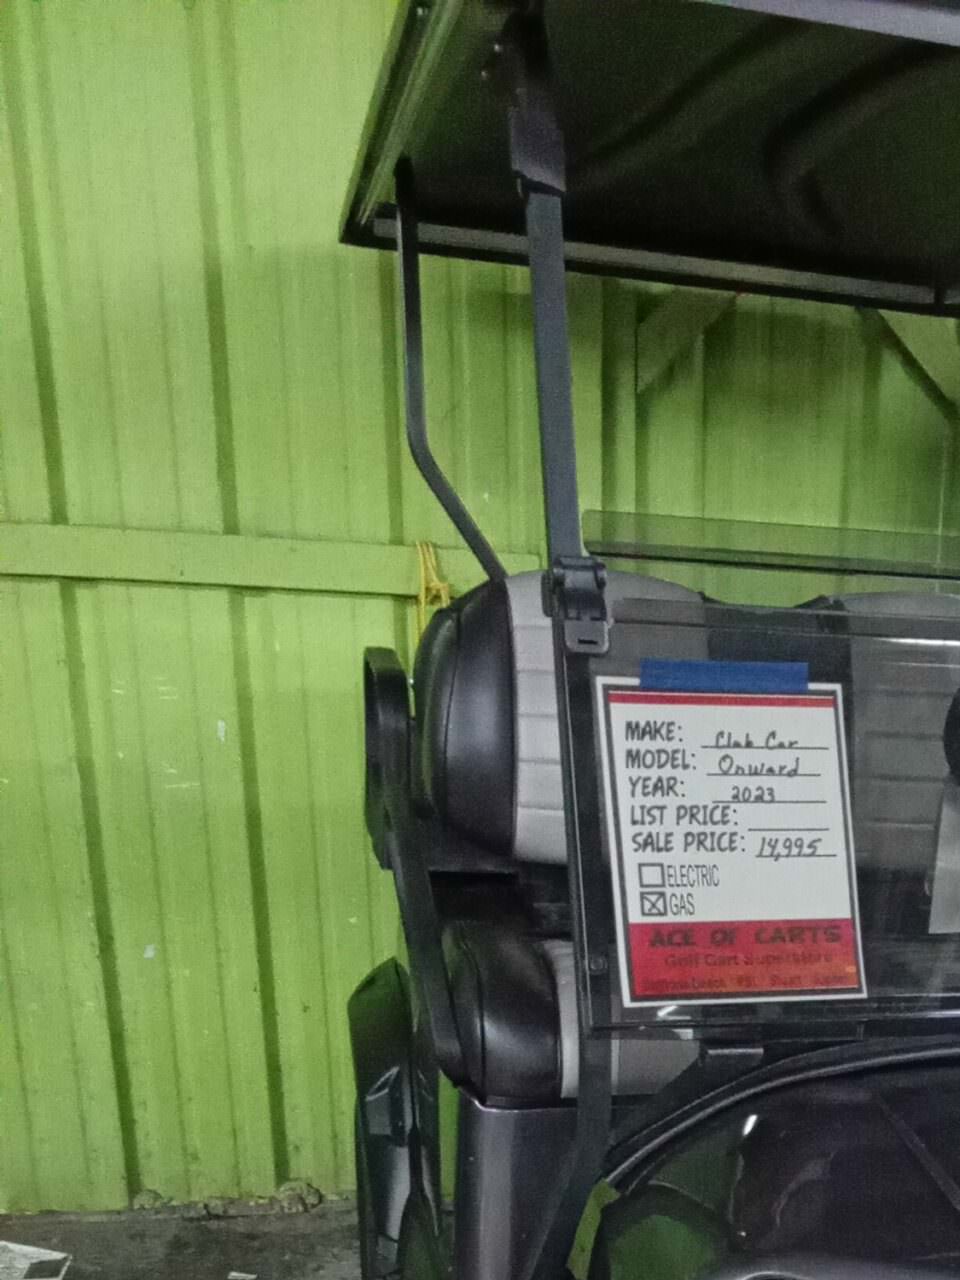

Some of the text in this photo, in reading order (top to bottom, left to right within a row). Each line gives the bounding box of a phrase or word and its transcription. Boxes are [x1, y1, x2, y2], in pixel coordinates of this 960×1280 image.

[625, 721, 683, 742] MAKE:
[764, 731, 799, 748] Car
[625, 749, 800, 777] MODEL: Onward
[629, 775, 775, 802] YEAR: 2023
[630, 804, 739, 826] LIST PRICE:
[632, 832, 674, 853] SALE
[683, 831, 746, 853] PRICE:
[667, 864, 720, 887] ELECTRIC
[669, 893, 695, 915] GAS
[650, 927, 696, 947] ACE
[755, 925, 842, 945] CARTS
